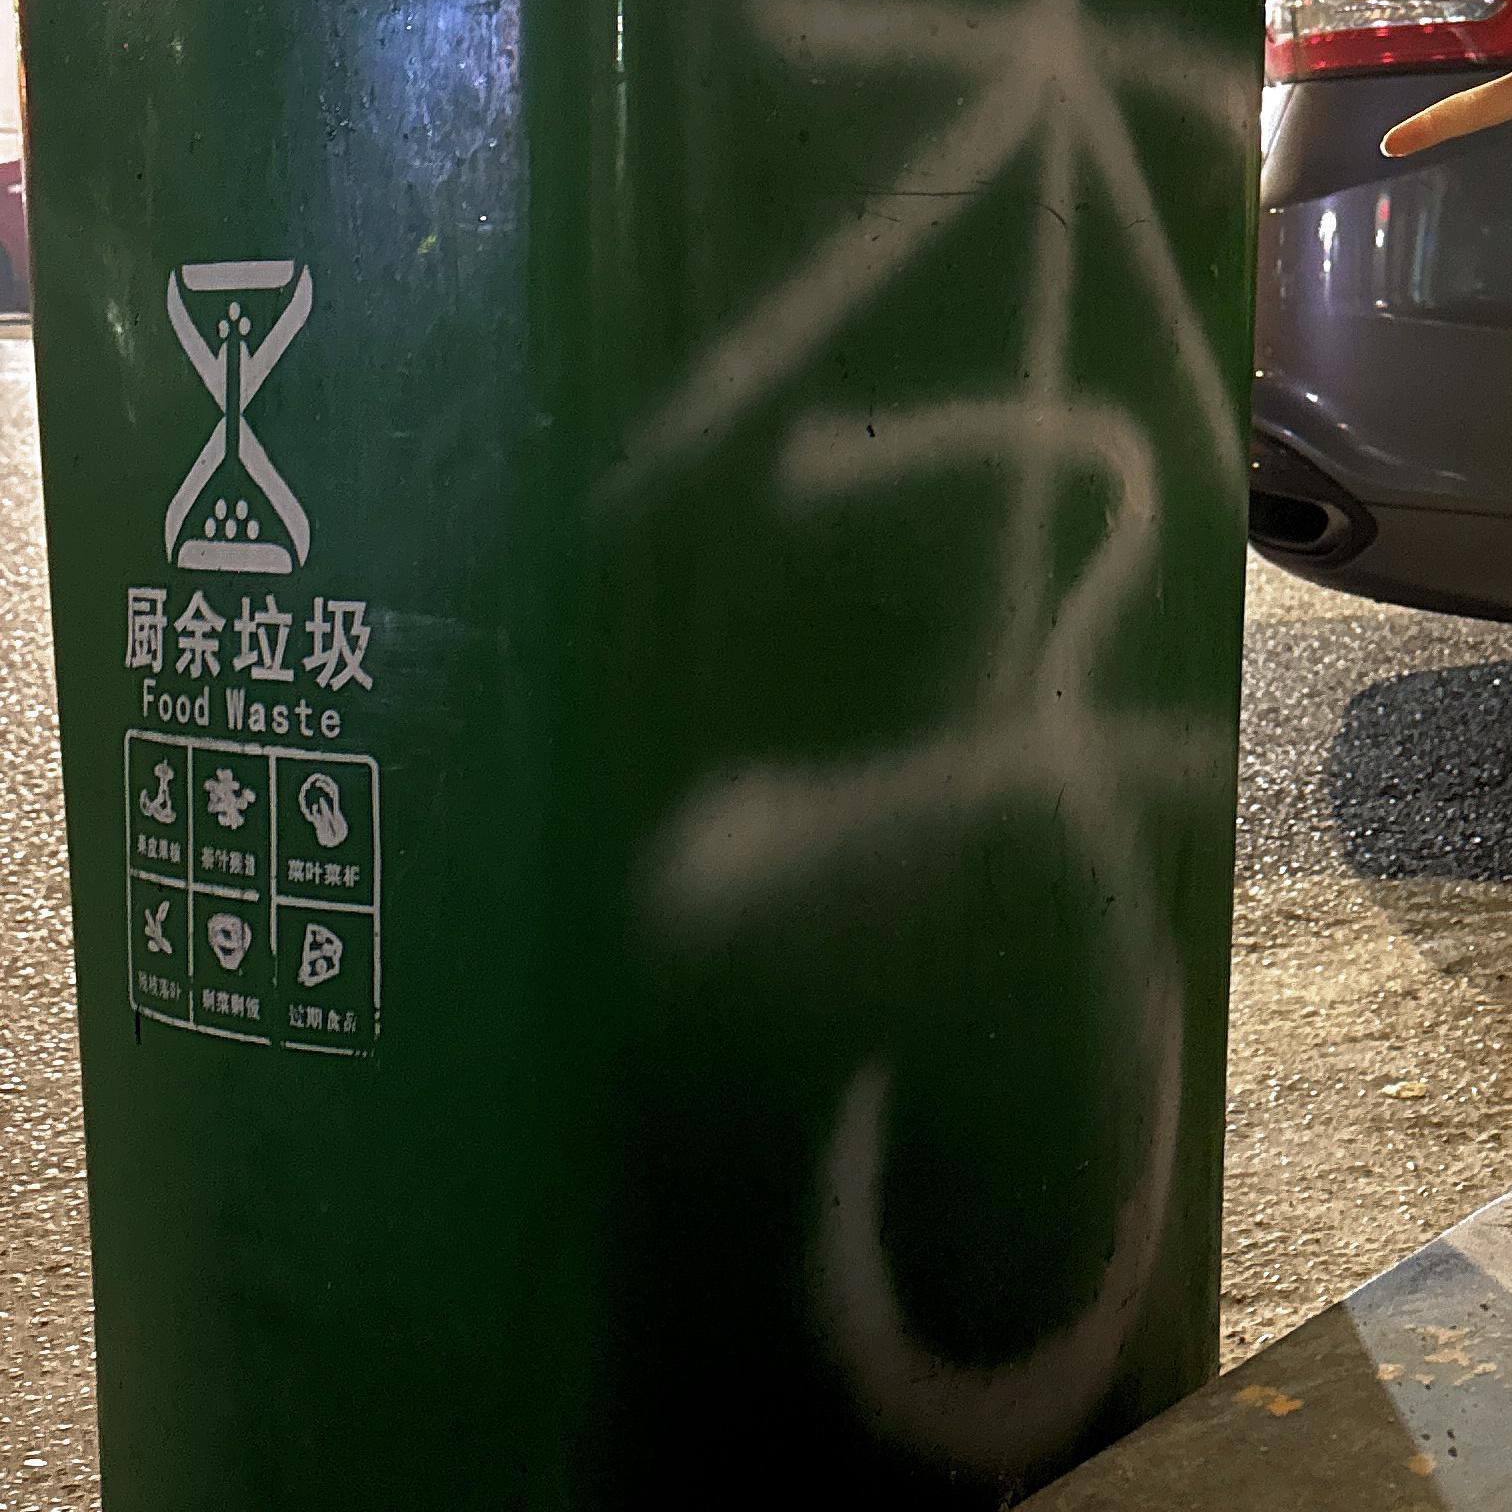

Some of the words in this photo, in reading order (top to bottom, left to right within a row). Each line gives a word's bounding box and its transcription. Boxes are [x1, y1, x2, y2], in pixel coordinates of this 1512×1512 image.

[125, 588, 374, 691] 厨余垃圾
[143, 678, 210, 727] Food
[225, 687, 341, 738] Waste
